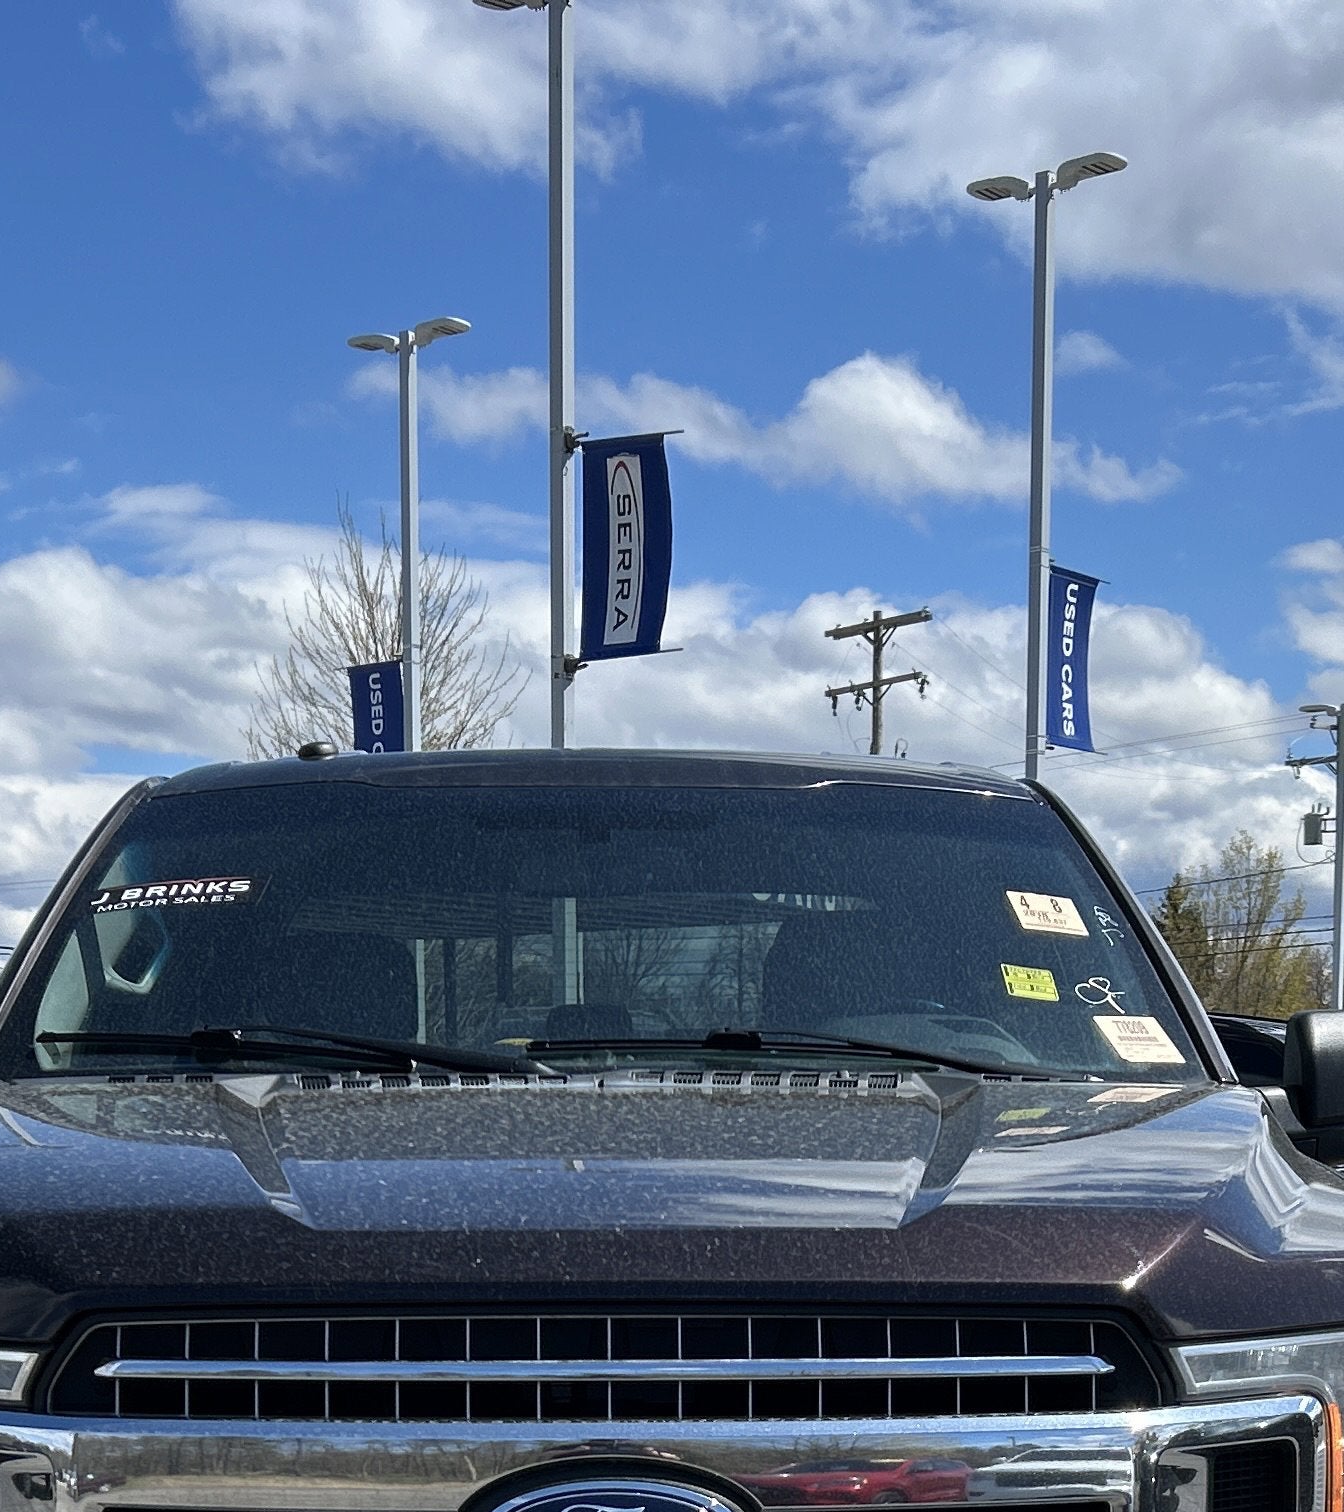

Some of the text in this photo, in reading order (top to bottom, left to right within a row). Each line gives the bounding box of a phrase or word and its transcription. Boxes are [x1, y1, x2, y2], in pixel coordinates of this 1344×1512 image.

[612, 493, 633, 632] SERRA
[1061, 583, 1079, 737] USED CARS
[369, 672, 384, 735] USED
[91, 879, 252, 906] J BRINKS
[96, 893, 236, 913] MOTOR SALES
